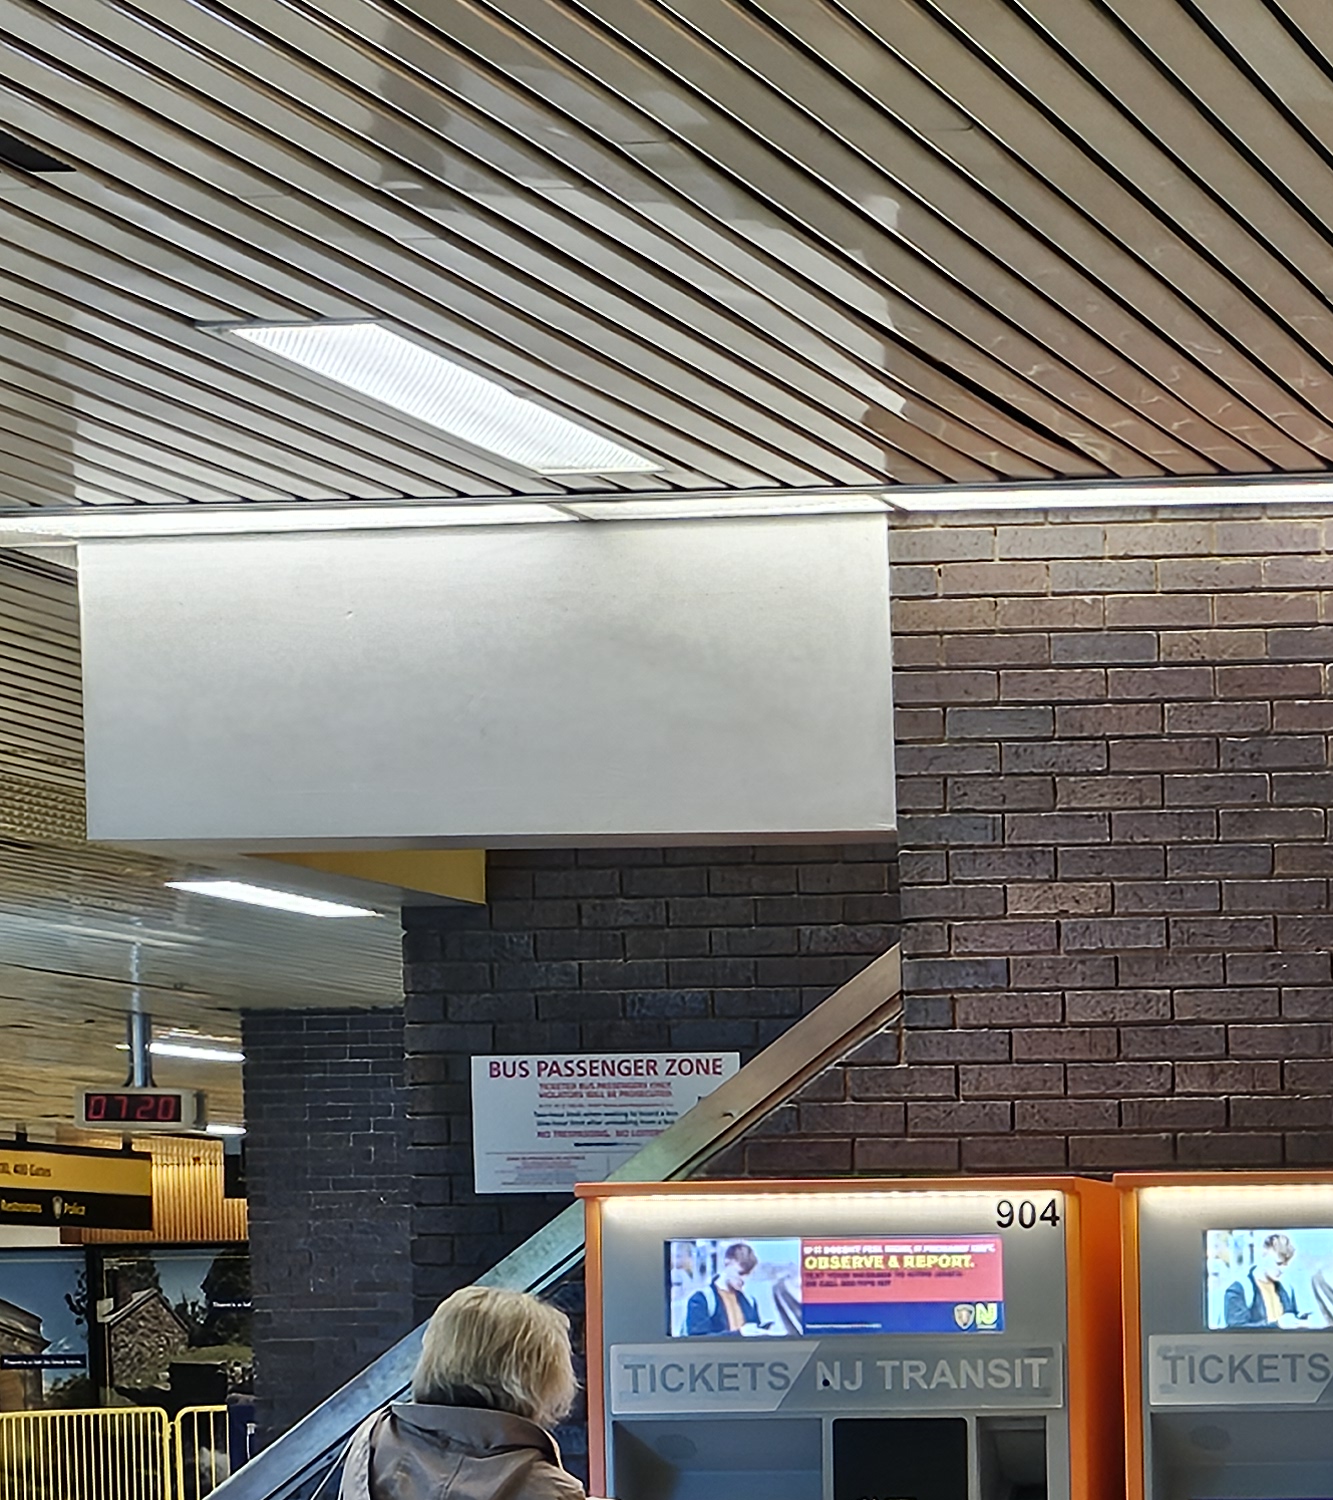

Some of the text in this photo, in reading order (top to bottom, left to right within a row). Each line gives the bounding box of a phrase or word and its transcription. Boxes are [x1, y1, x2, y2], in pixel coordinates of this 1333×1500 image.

[488, 1057, 722, 1078] BUS PASSENGER ZONE
[995, 1199, 1060, 1229] 904
[804, 1255, 884, 1270] OBSERVE
[624, 1361, 791, 1393] TICKETS
[816, 1357, 1048, 1391] NJ TRANSIT
[1163, 1353, 1330, 1385] TICKETS
